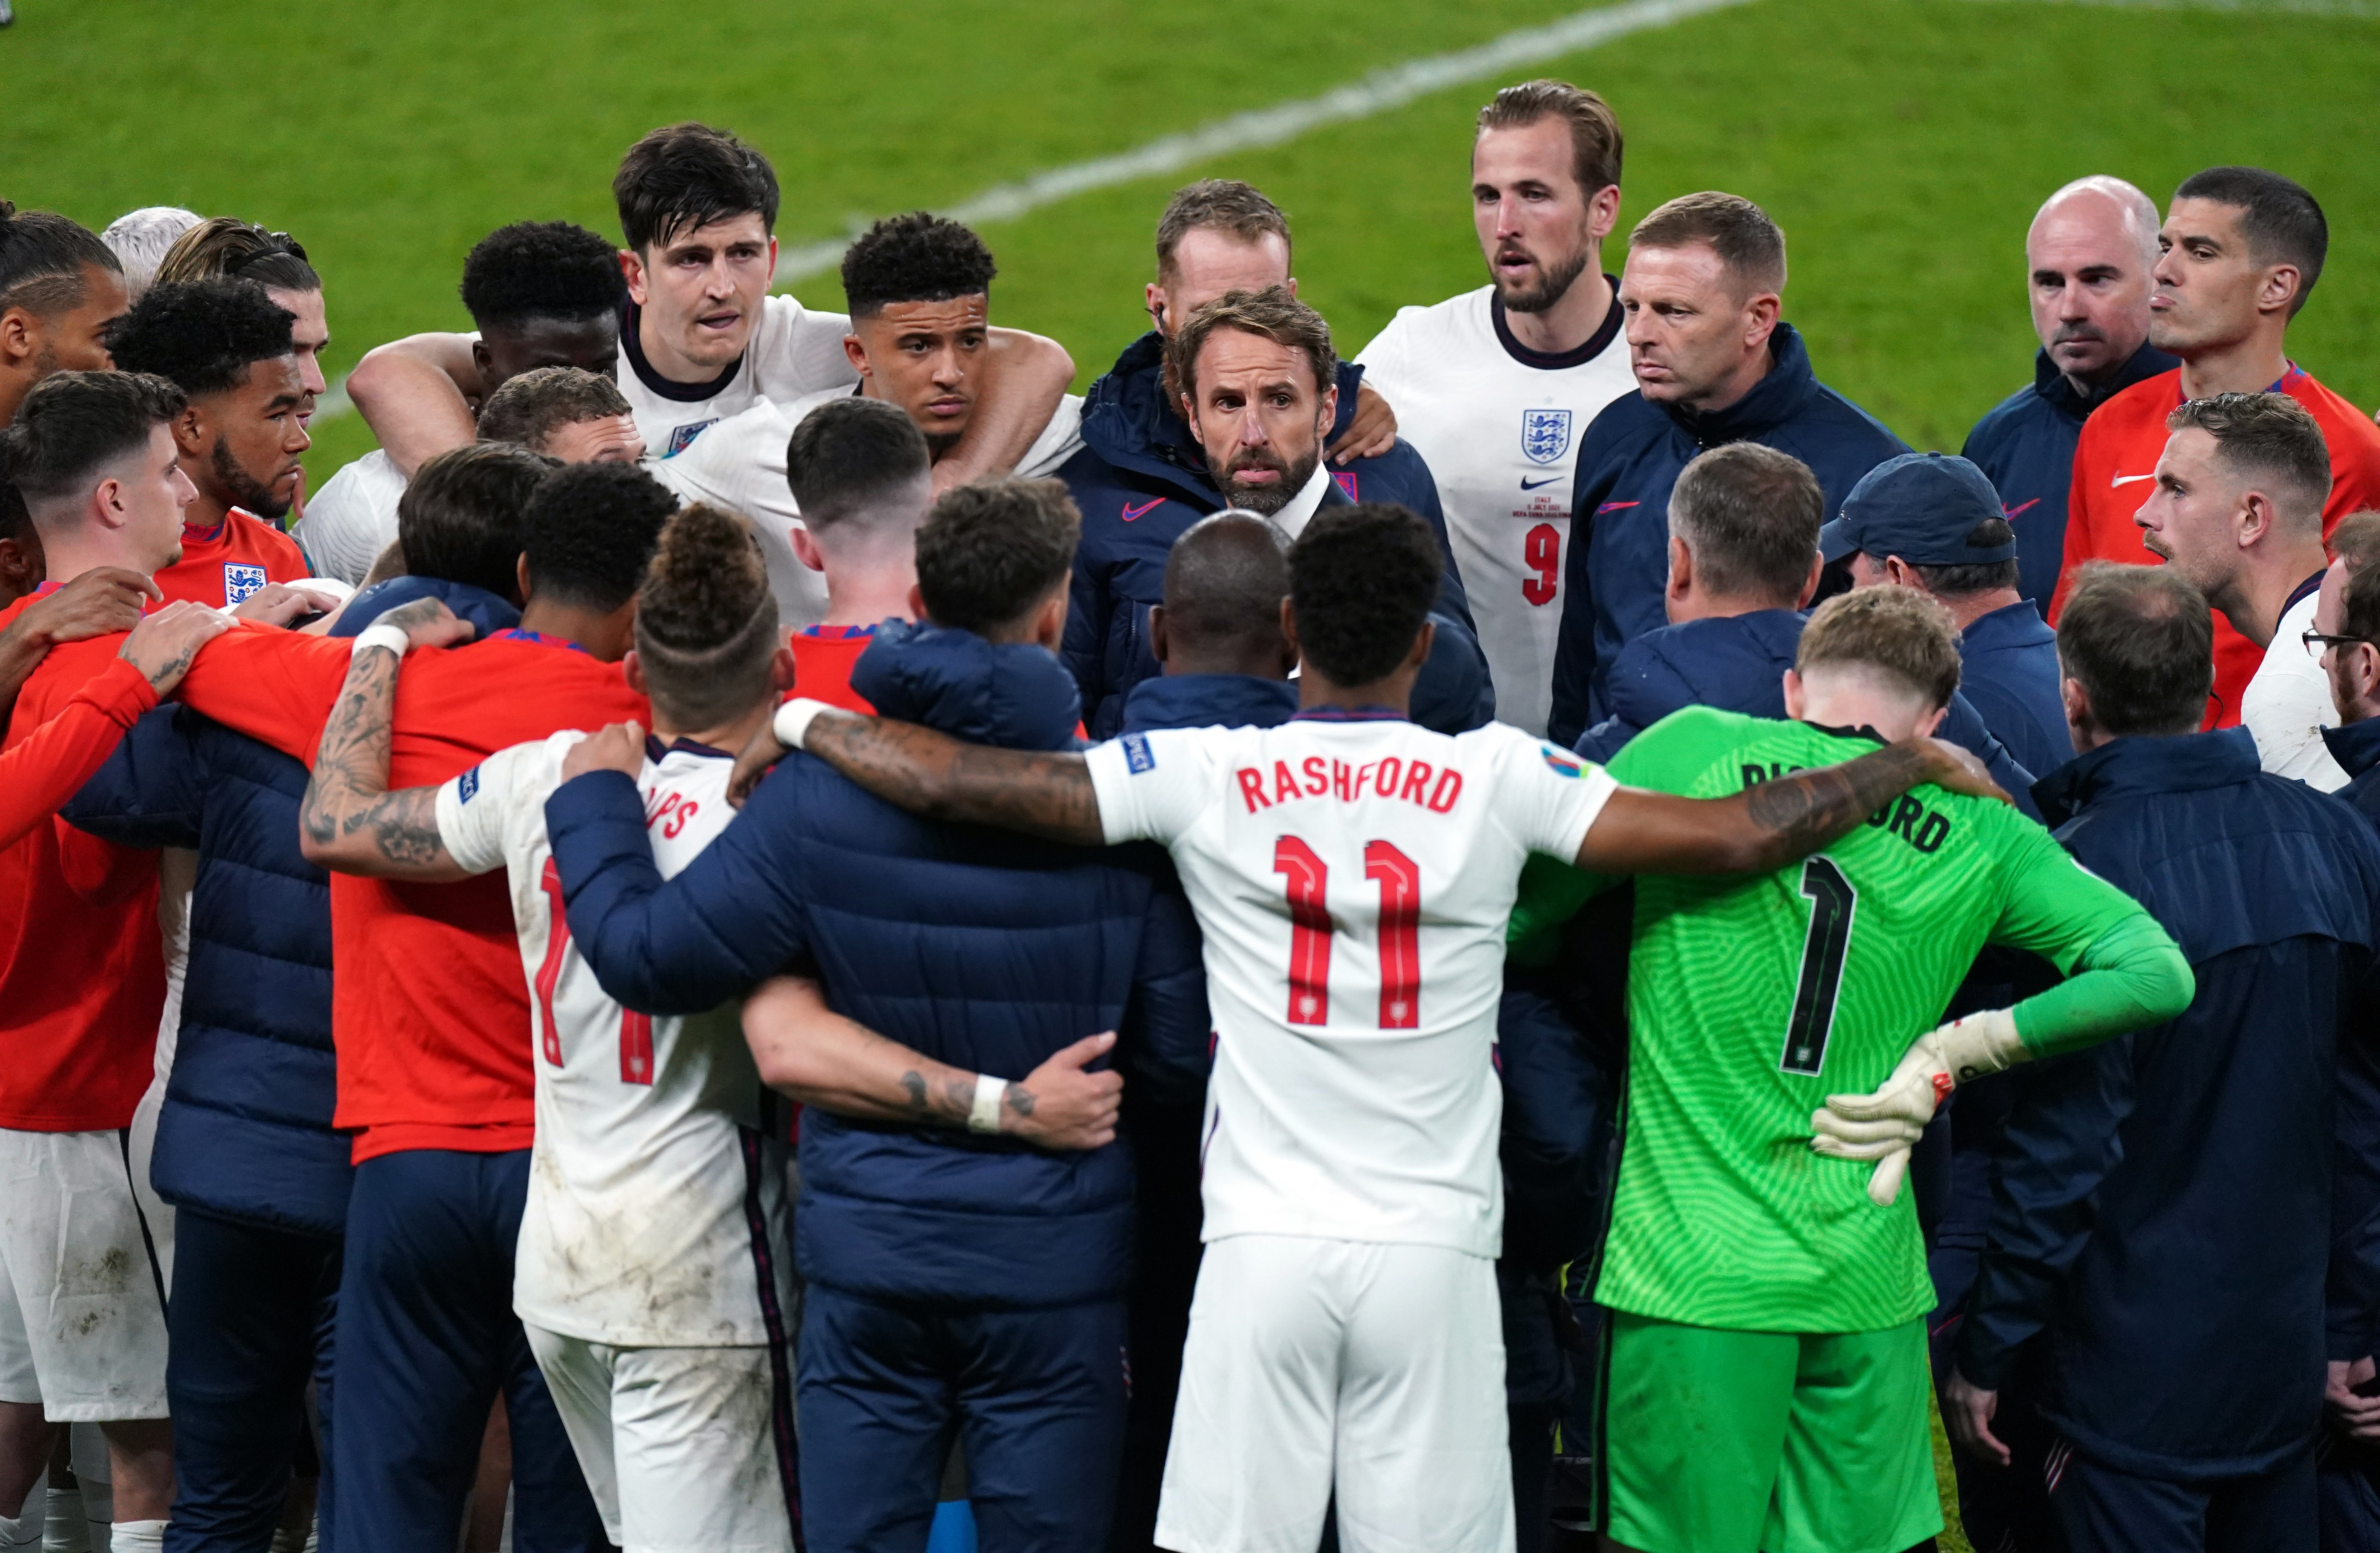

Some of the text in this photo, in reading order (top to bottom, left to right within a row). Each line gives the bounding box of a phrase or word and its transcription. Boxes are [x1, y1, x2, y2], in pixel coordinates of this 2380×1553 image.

[1522, 523, 1560, 606] 9
[1236, 757, 1462, 815] RASHFORD
[1274, 835, 1420, 1029] 11
[1780, 853, 1858, 1077] 1
